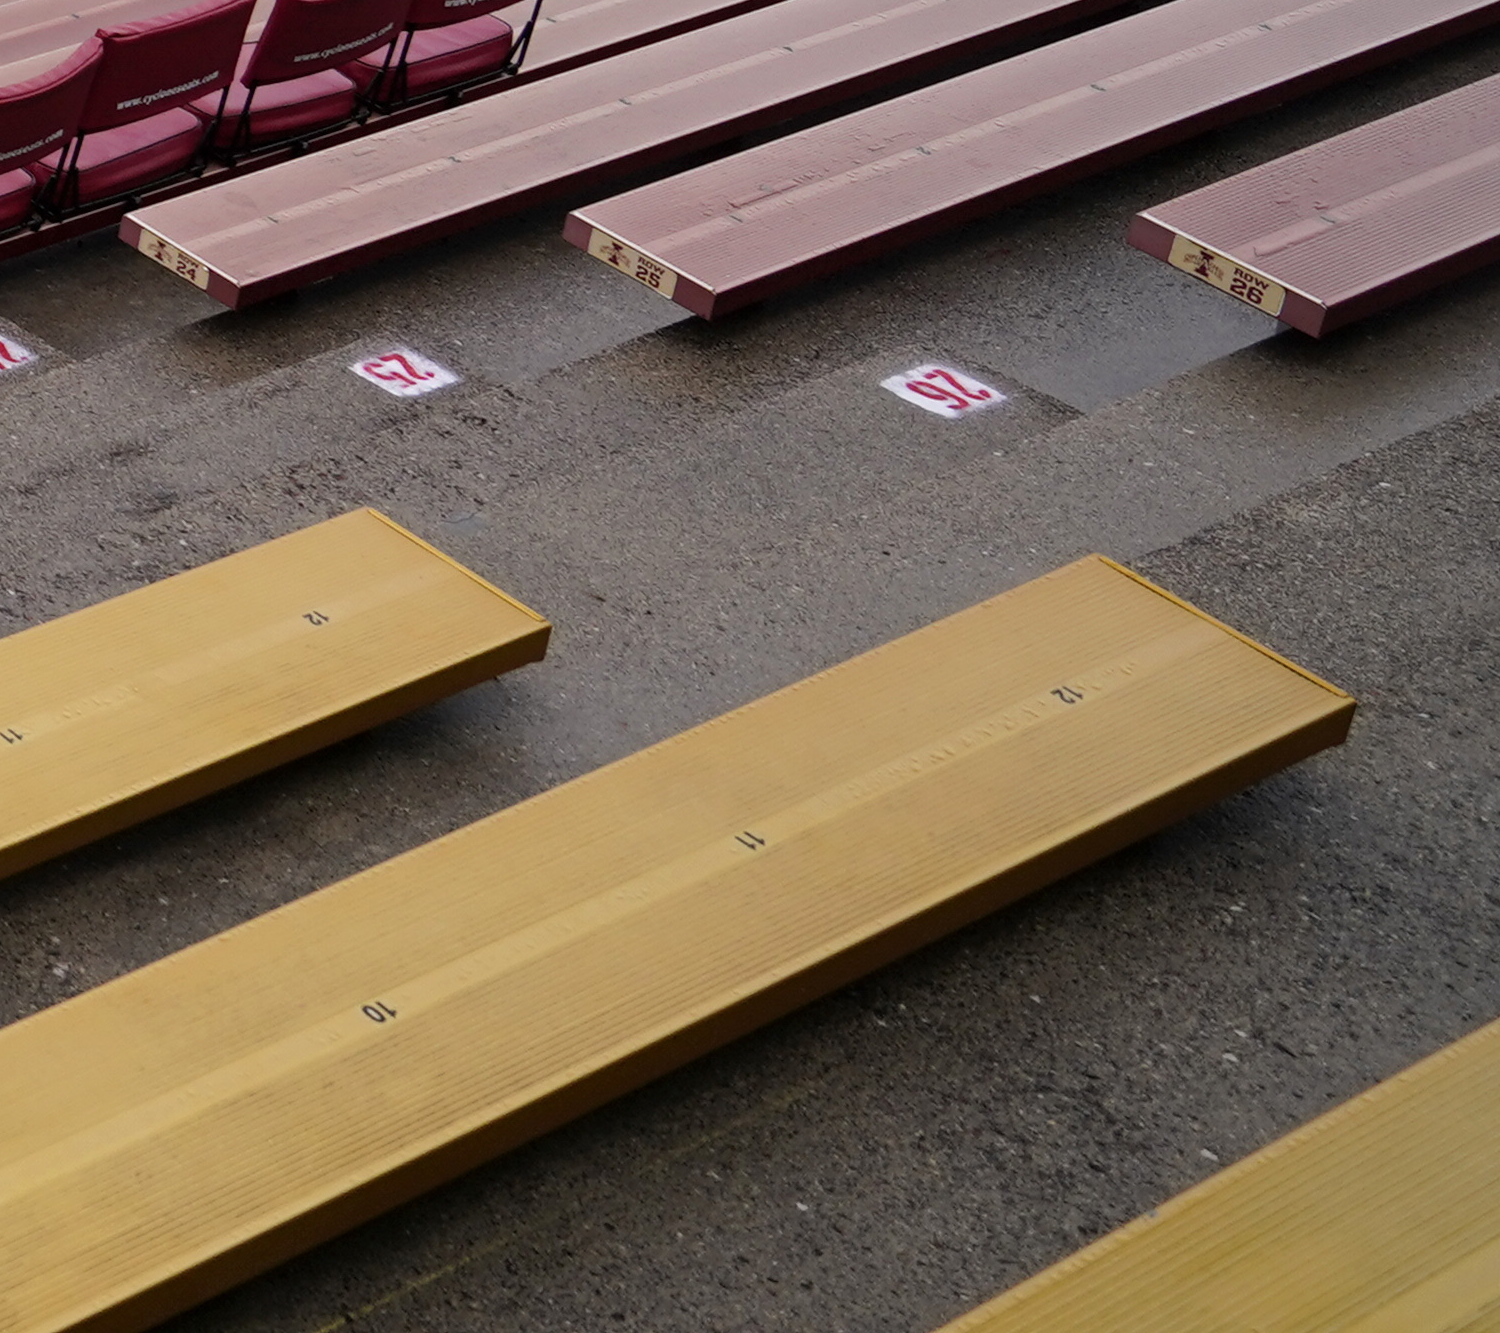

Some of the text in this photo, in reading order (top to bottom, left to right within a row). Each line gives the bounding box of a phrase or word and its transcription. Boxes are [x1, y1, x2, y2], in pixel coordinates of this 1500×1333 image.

[633, 268, 662, 290] 25
[635, 258, 664, 278] ROW
[1232, 266, 1271, 290] ROW
[1229, 278, 1266, 305] 26
[361, 353, 437, 388] 25
[903, 369, 993, 411] 26
